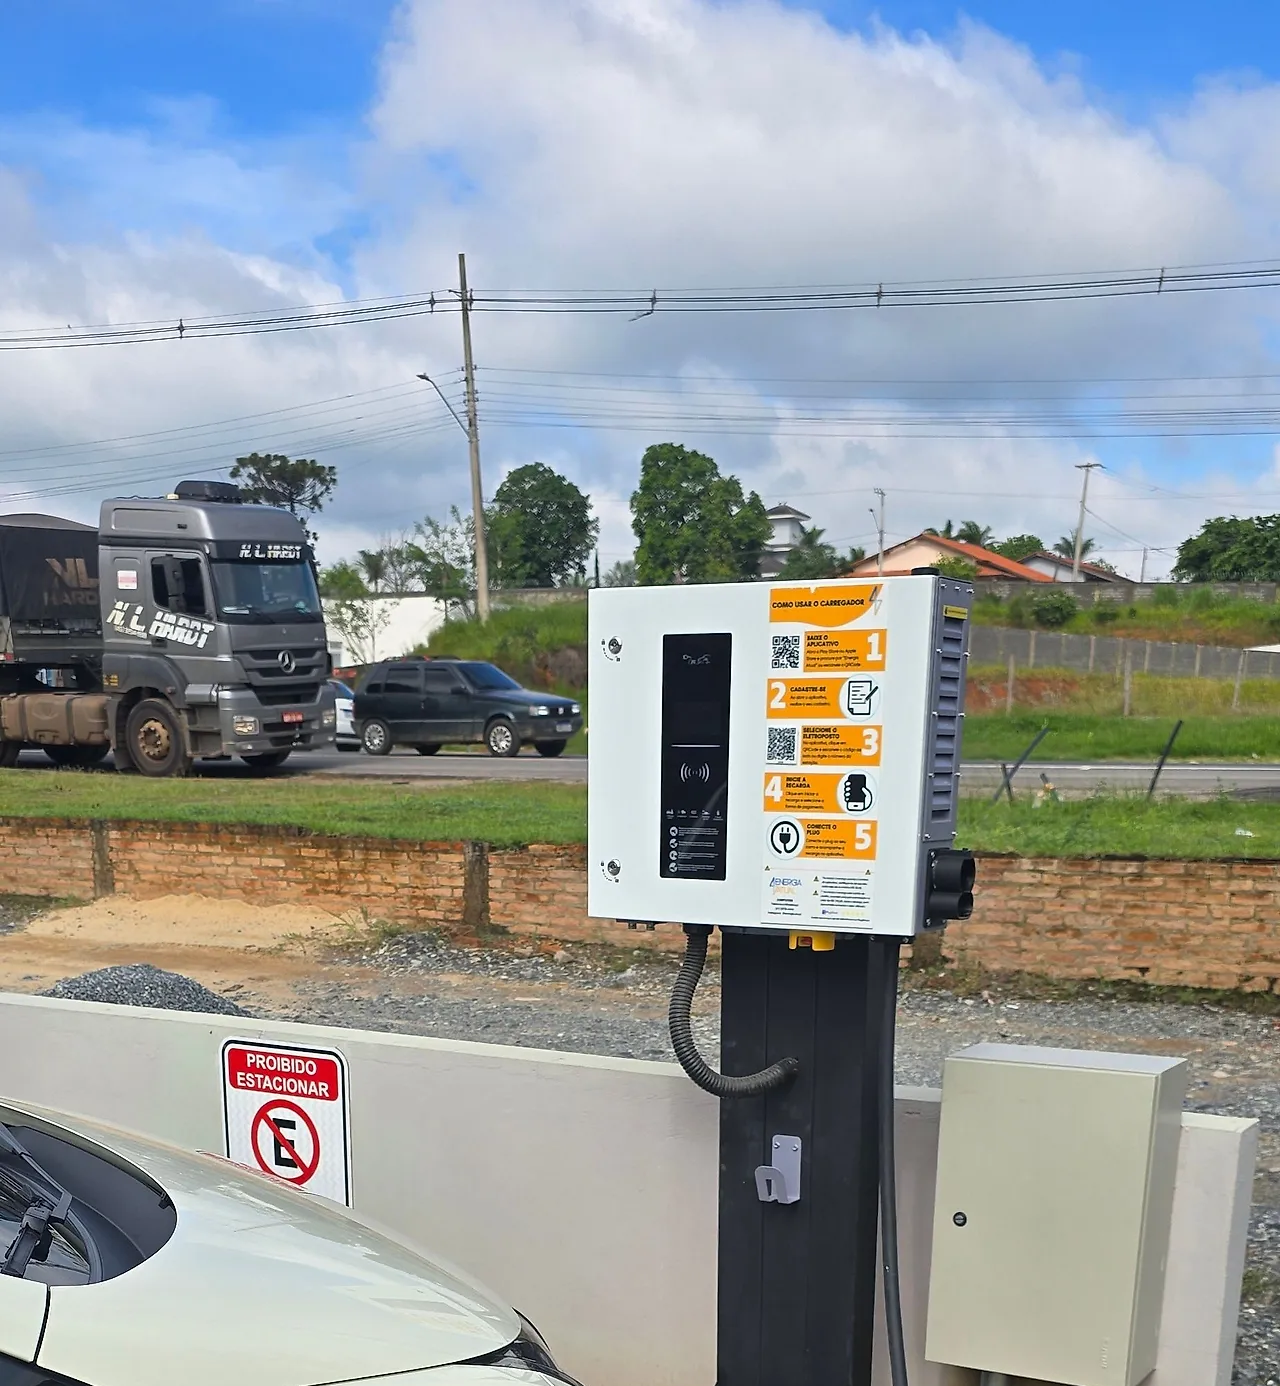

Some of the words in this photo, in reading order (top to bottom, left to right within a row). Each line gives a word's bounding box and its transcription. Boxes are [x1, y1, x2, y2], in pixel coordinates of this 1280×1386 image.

[795, 600, 812, 608] USAR
[129, 605, 146, 632] L
[149, 611, 215, 649] HARDT
[866, 632, 882, 661] 1
[770, 681, 786, 709] 2
[861, 728, 878, 756] 3
[765, 775, 783, 802] 4
[855, 823, 871, 850] 5
[246, 1053, 317, 1075] PROIBIDO
[236, 1071, 330, 1097] ESTACIONAR
[272, 1118, 298, 1169] E
